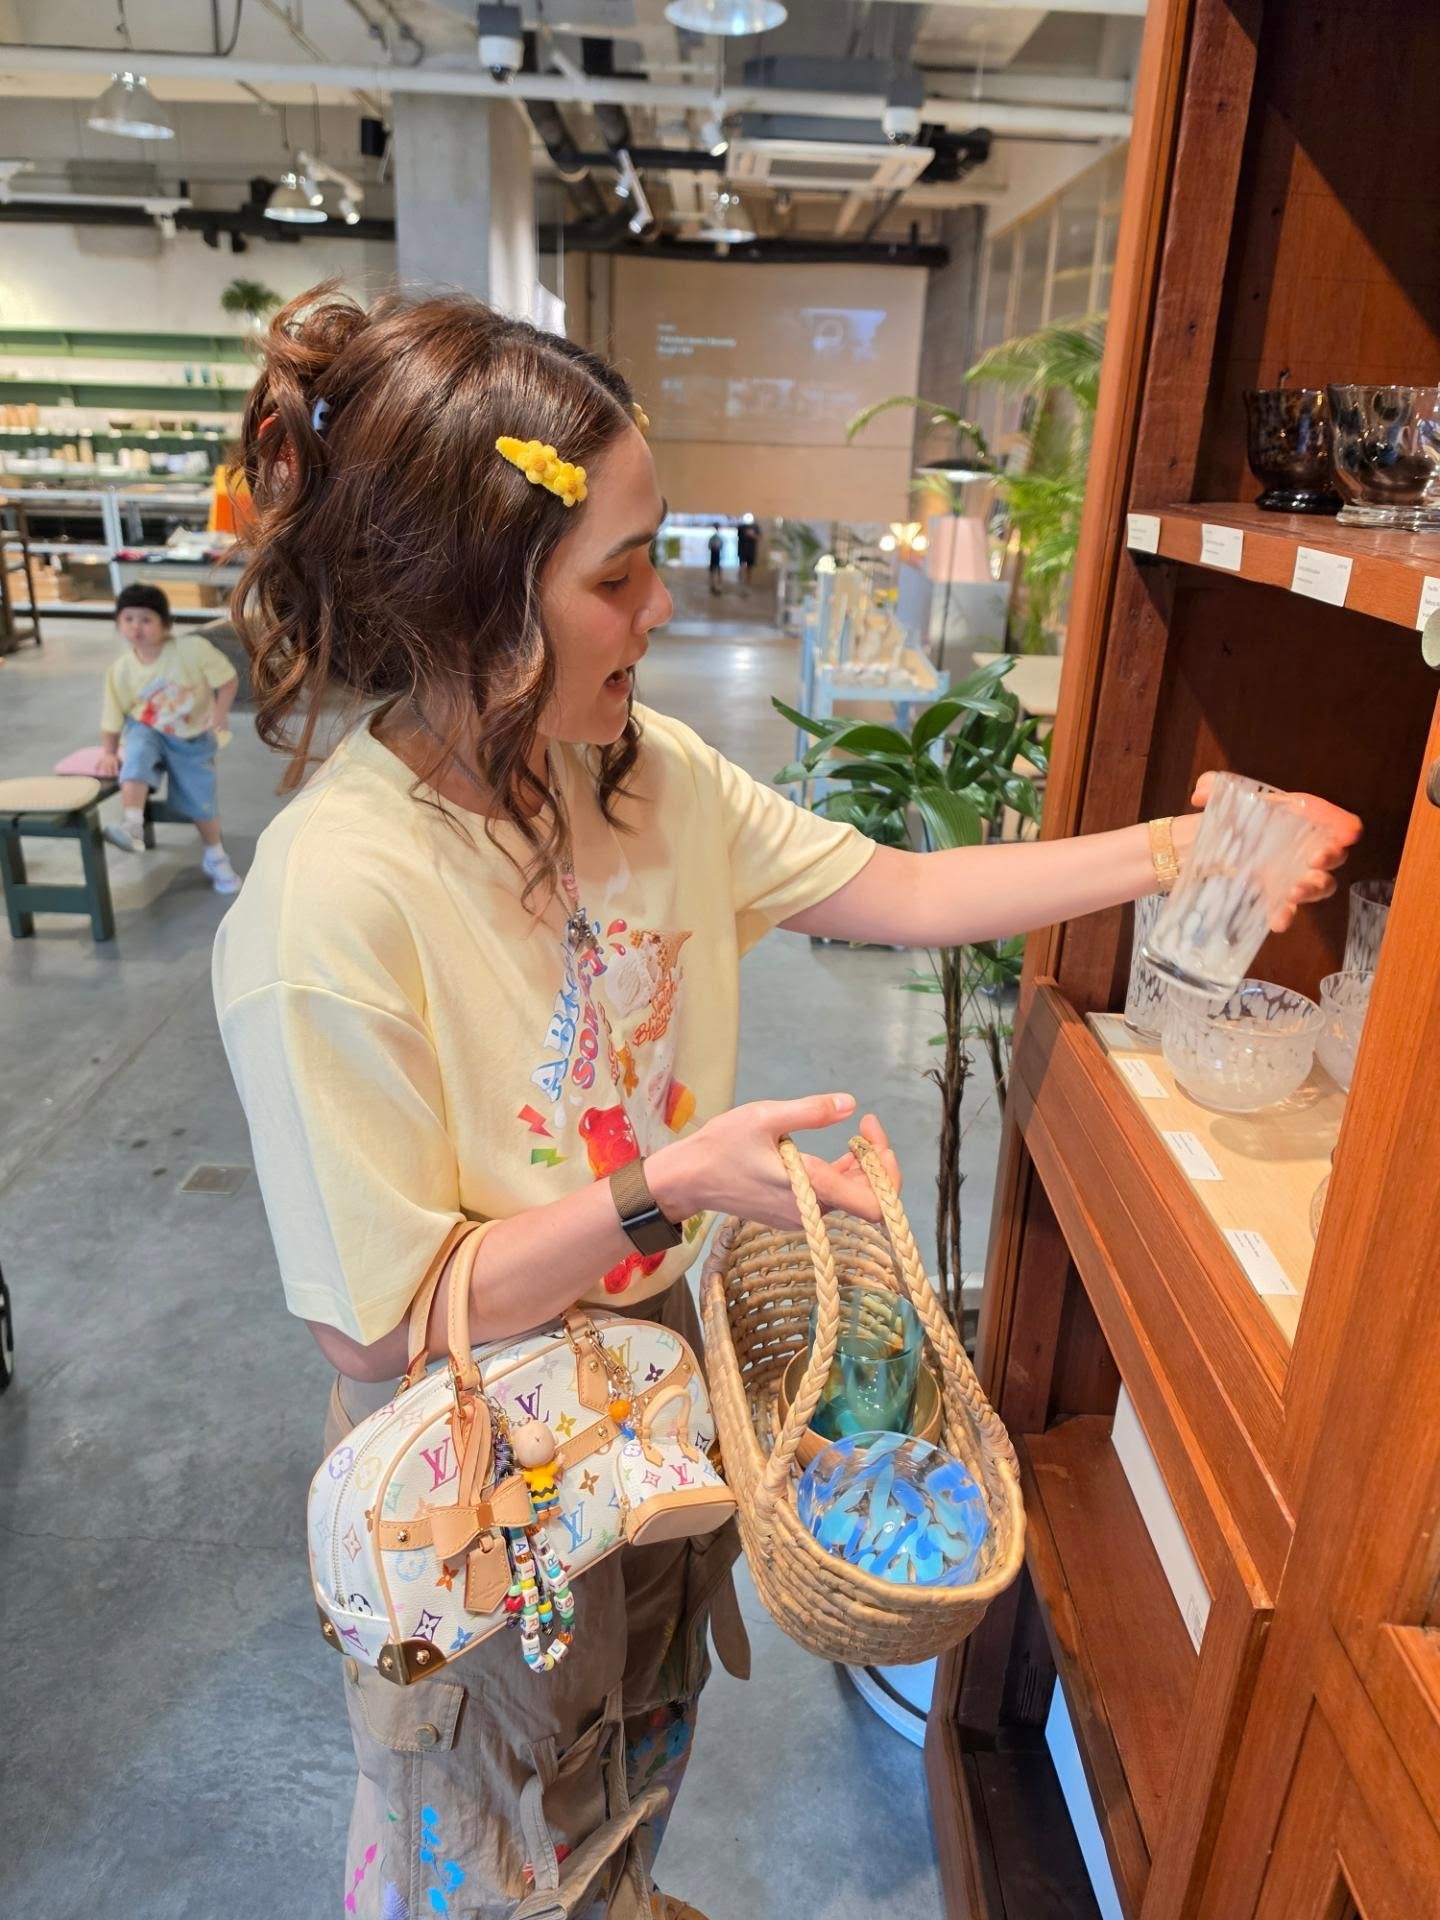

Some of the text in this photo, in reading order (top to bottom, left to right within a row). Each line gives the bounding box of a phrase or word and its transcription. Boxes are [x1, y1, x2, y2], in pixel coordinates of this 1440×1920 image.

[419, 1436, 459, 1493] LV
[669, 1463, 695, 1486] LV
[557, 1500, 593, 1554] LV
